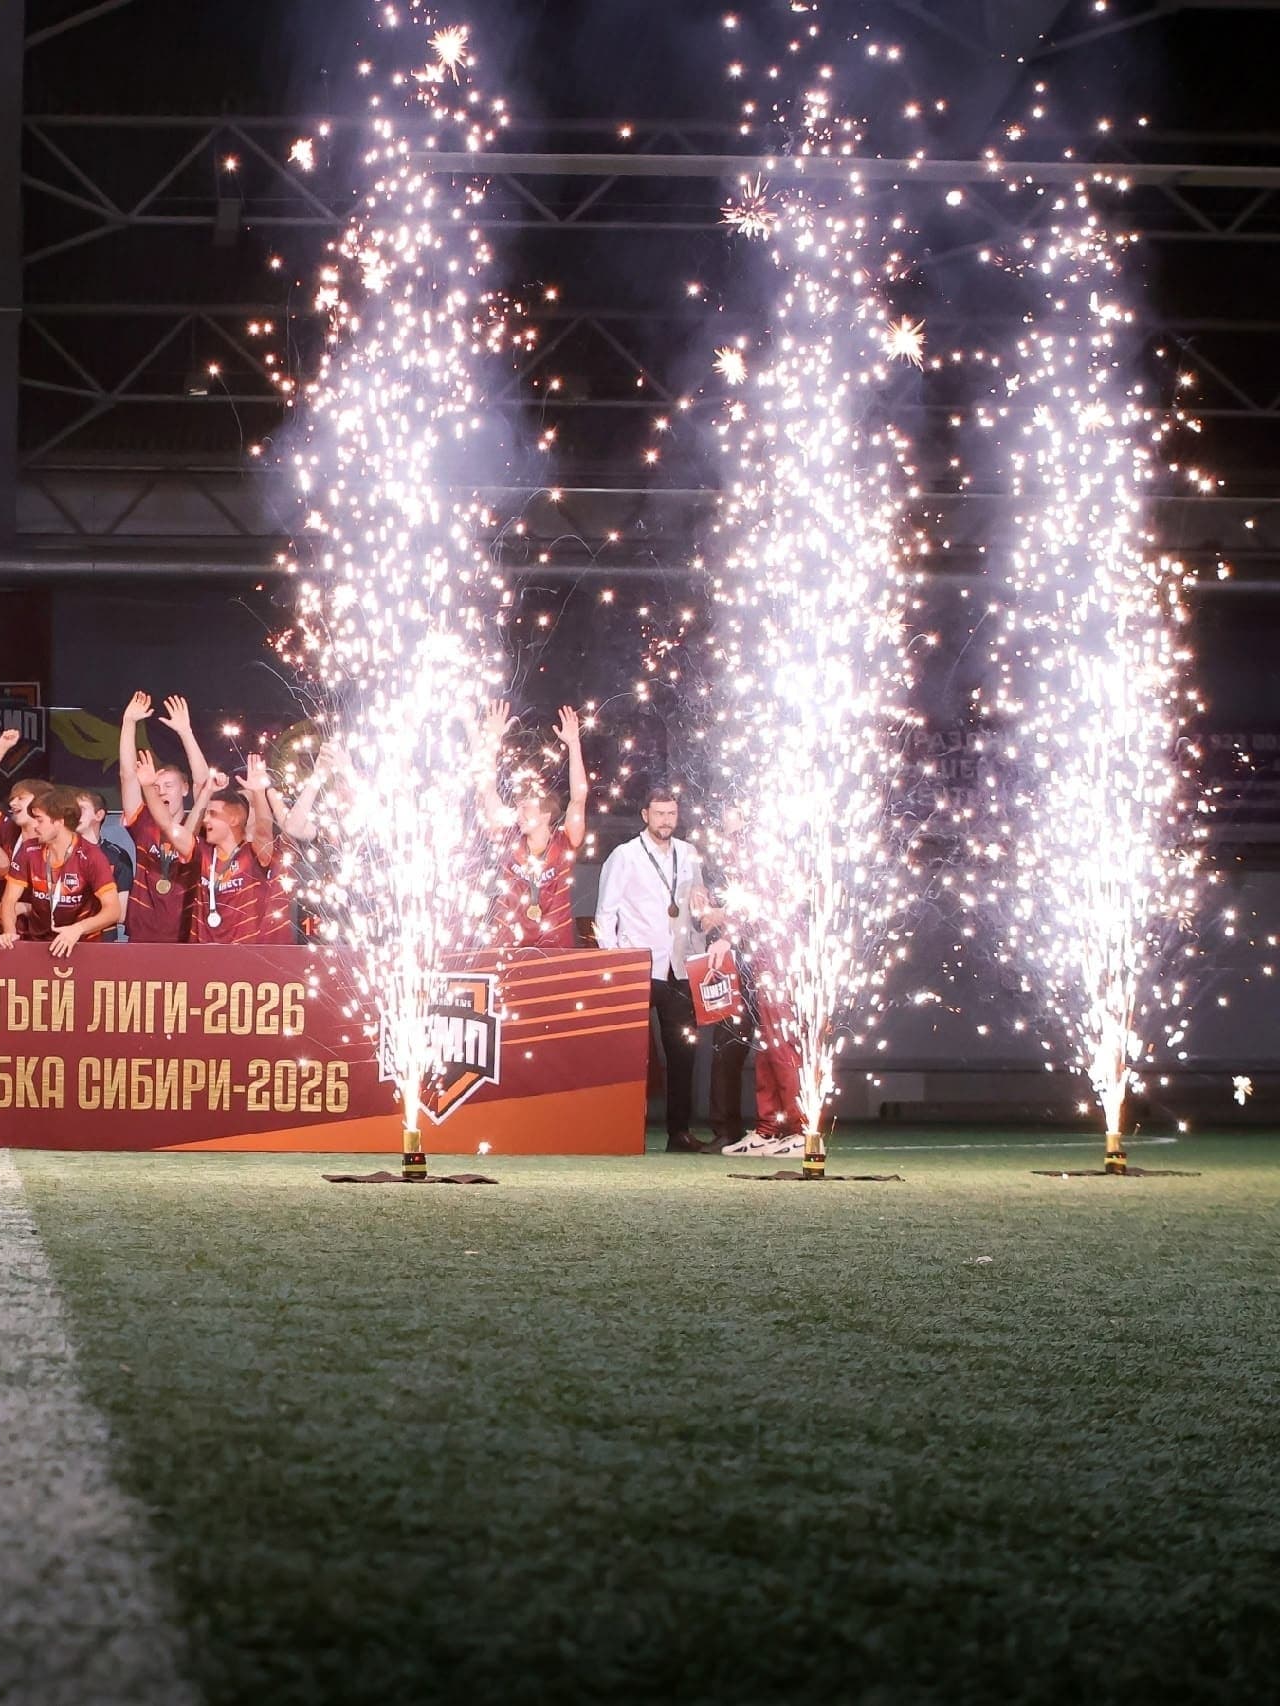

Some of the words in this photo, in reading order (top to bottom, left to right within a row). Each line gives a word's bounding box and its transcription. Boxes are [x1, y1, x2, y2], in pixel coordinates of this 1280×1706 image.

[87, 981, 305, 1036] ЛИГИ-2026
[396, 1014, 488, 1068] ЕМП
[78, 1056, 350, 1113] СИБИРИ-2026
